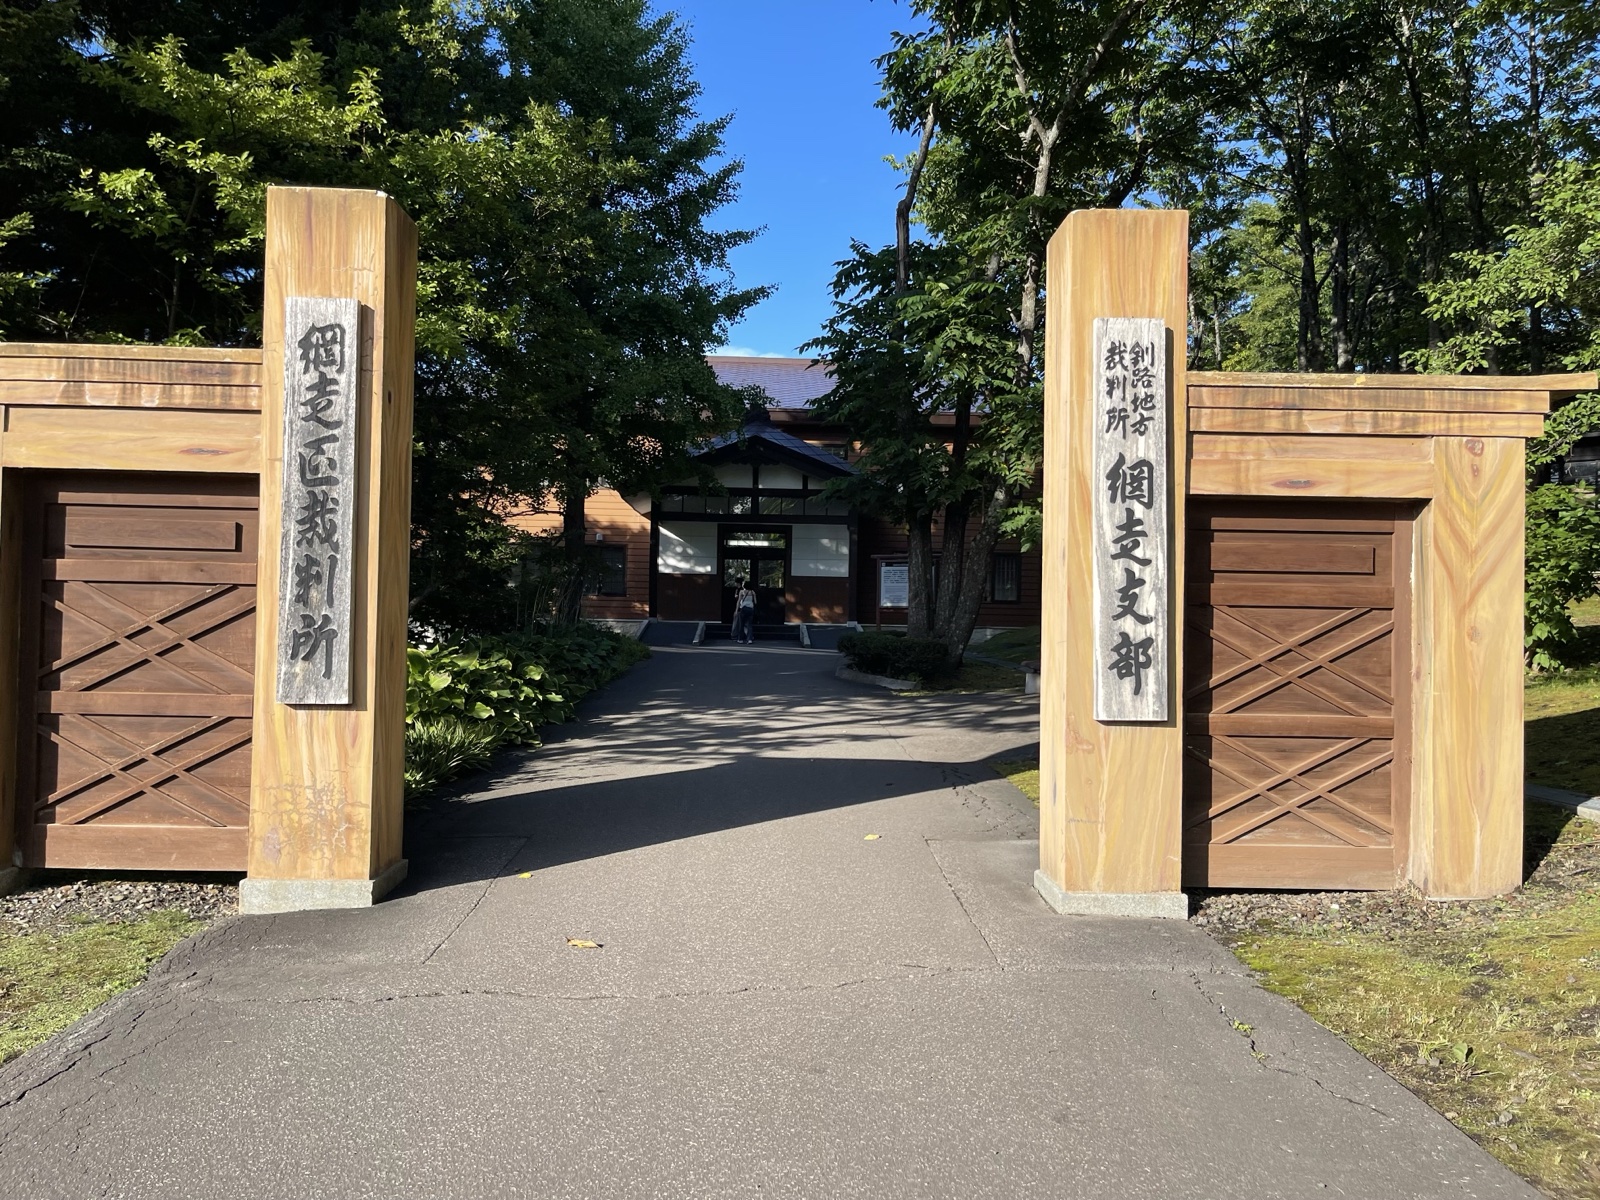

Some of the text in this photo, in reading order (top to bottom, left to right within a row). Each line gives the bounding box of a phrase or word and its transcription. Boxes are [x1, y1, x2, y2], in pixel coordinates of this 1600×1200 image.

[1105, 340, 1130, 440] 裁判所
[1129, 341, 1156, 437] 釧路地方
[1105, 451, 1155, 696] 網走支部
